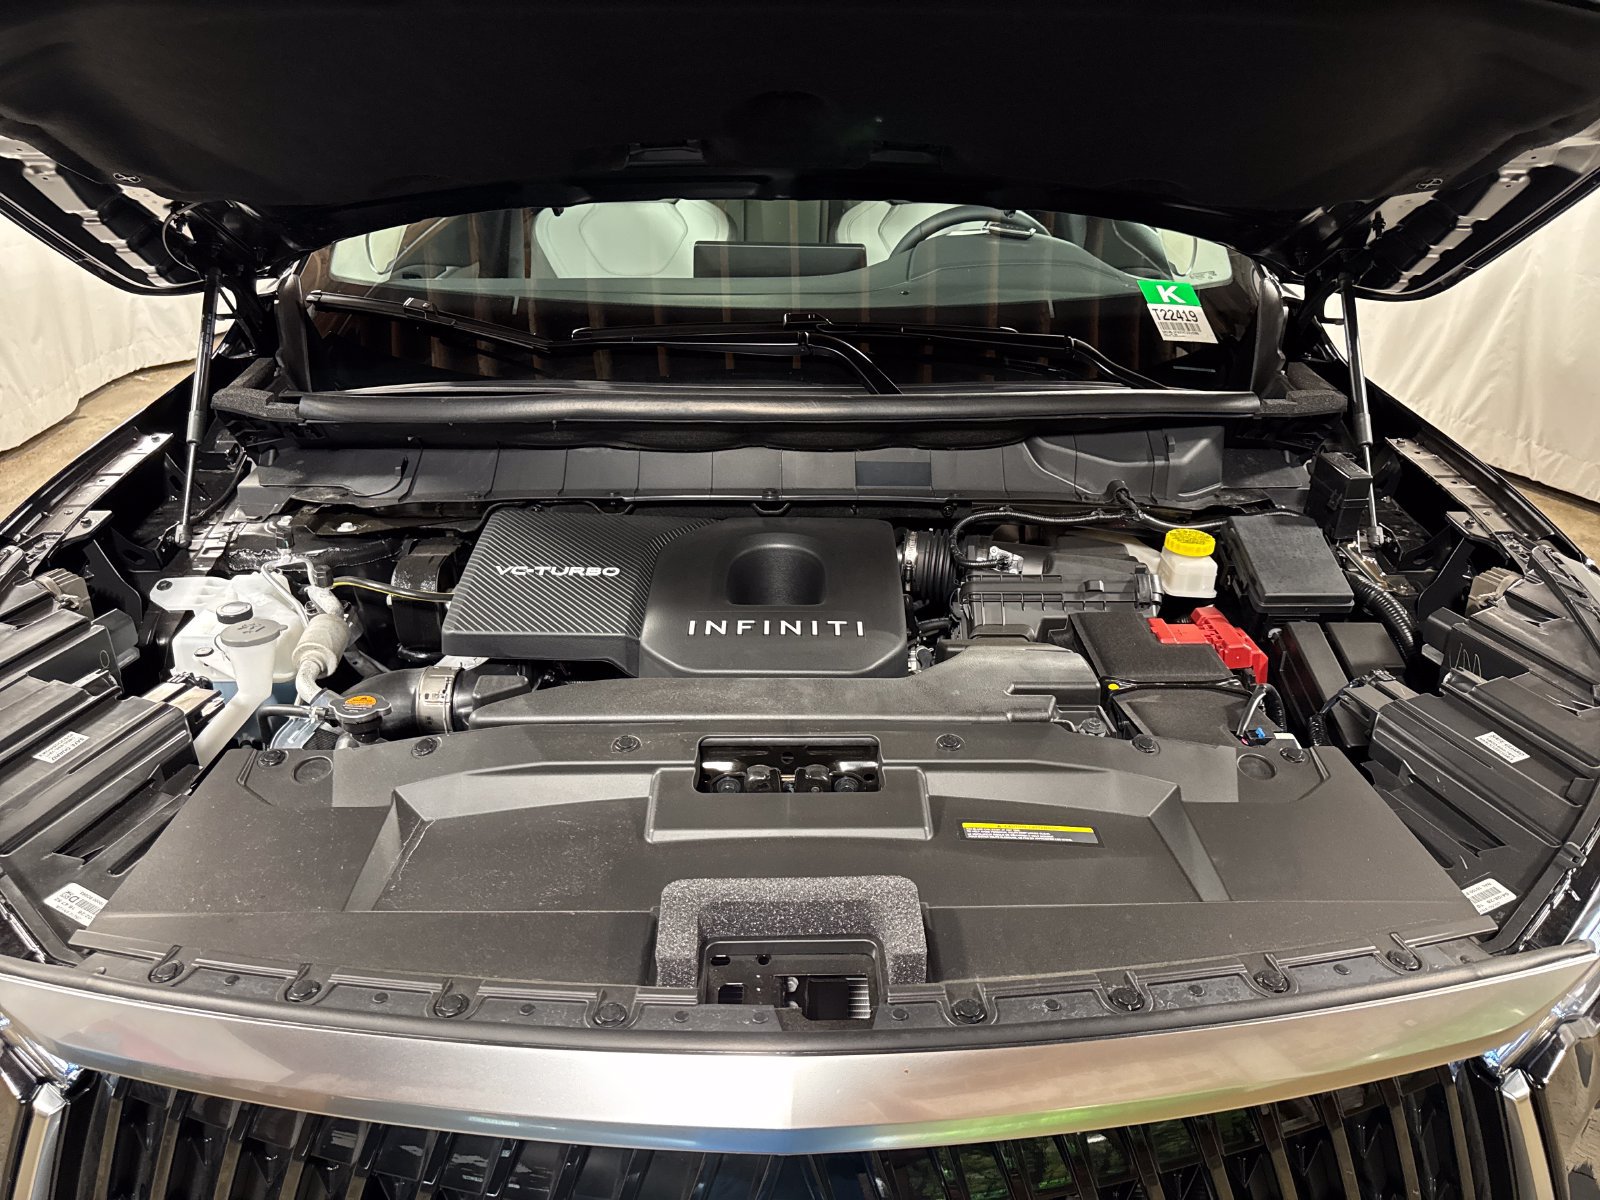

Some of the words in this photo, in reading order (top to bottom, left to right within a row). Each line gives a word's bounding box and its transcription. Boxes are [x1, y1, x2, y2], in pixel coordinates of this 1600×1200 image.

[1156, 285, 1187, 303] K
[1152, 308, 1198, 322] T22419
[495, 565, 620, 576] VC-TURBO
[688, 620, 865, 636] INFINITI
